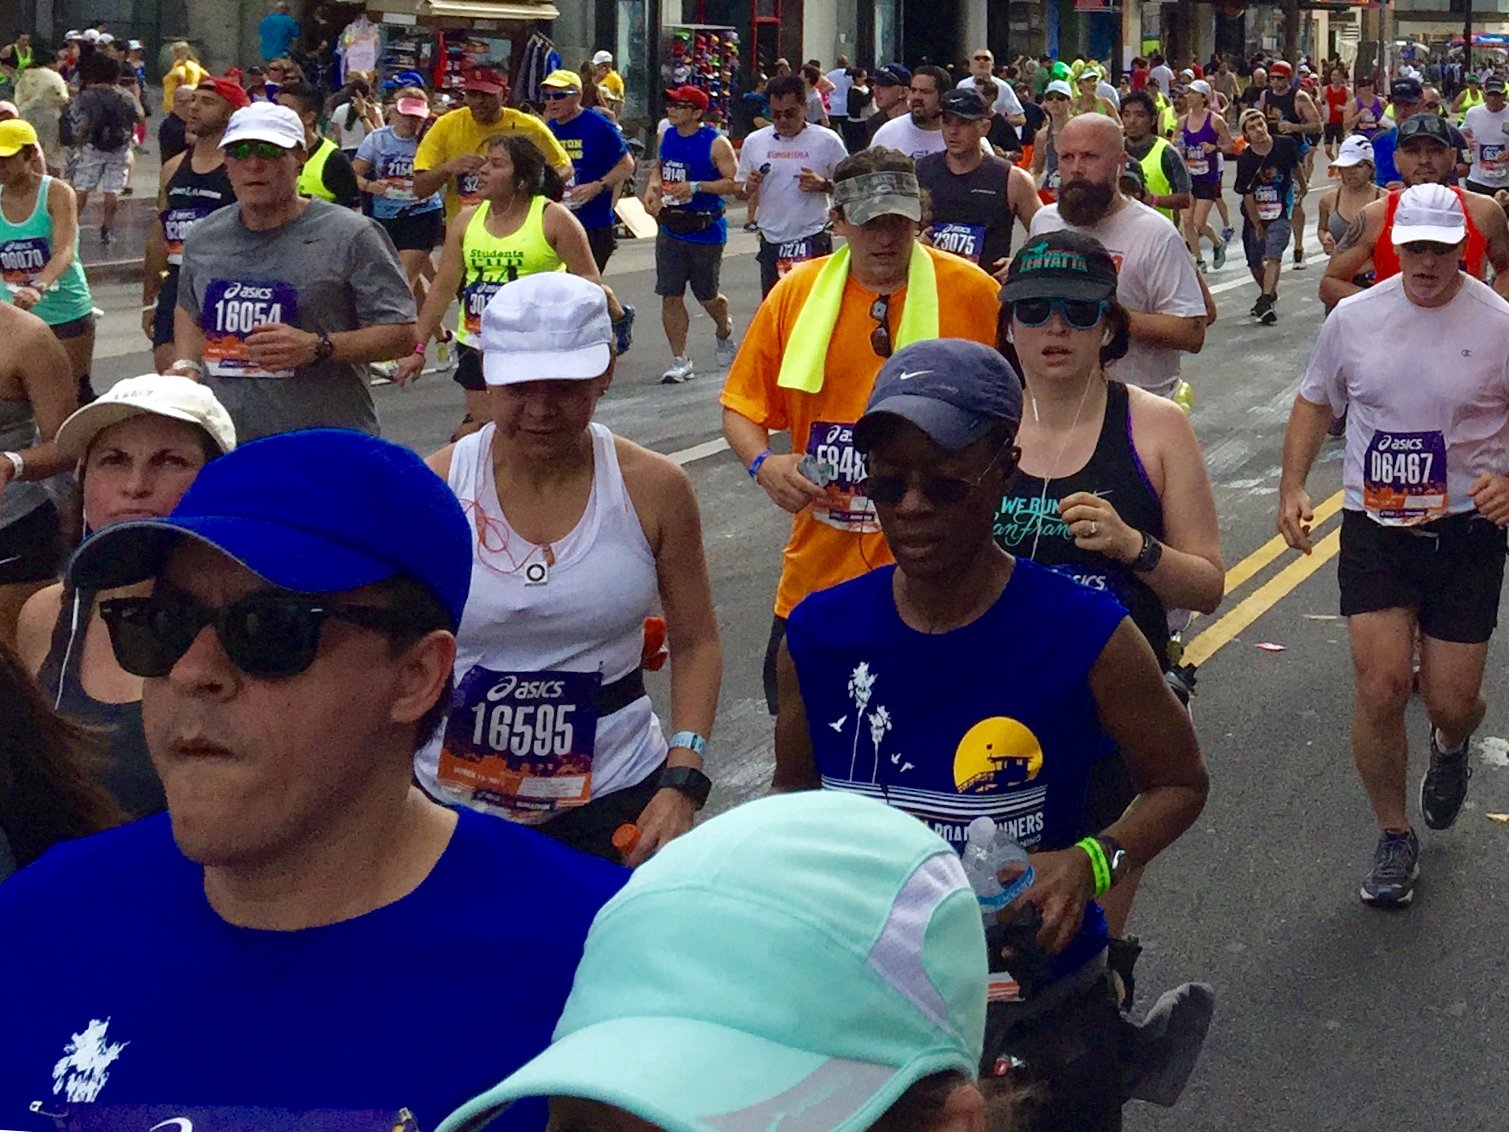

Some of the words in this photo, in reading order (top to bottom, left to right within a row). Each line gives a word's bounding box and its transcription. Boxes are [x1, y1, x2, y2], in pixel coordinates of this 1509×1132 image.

[933, 231, 977, 255] 23075
[470, 249, 525, 258] Students
[214, 300, 282, 333] 16054
[1391, 438, 1423, 450] asics
[1001, 496, 1027, 514] WE
[514, 680, 565, 699] asics
[471, 702, 576, 757] 16595
